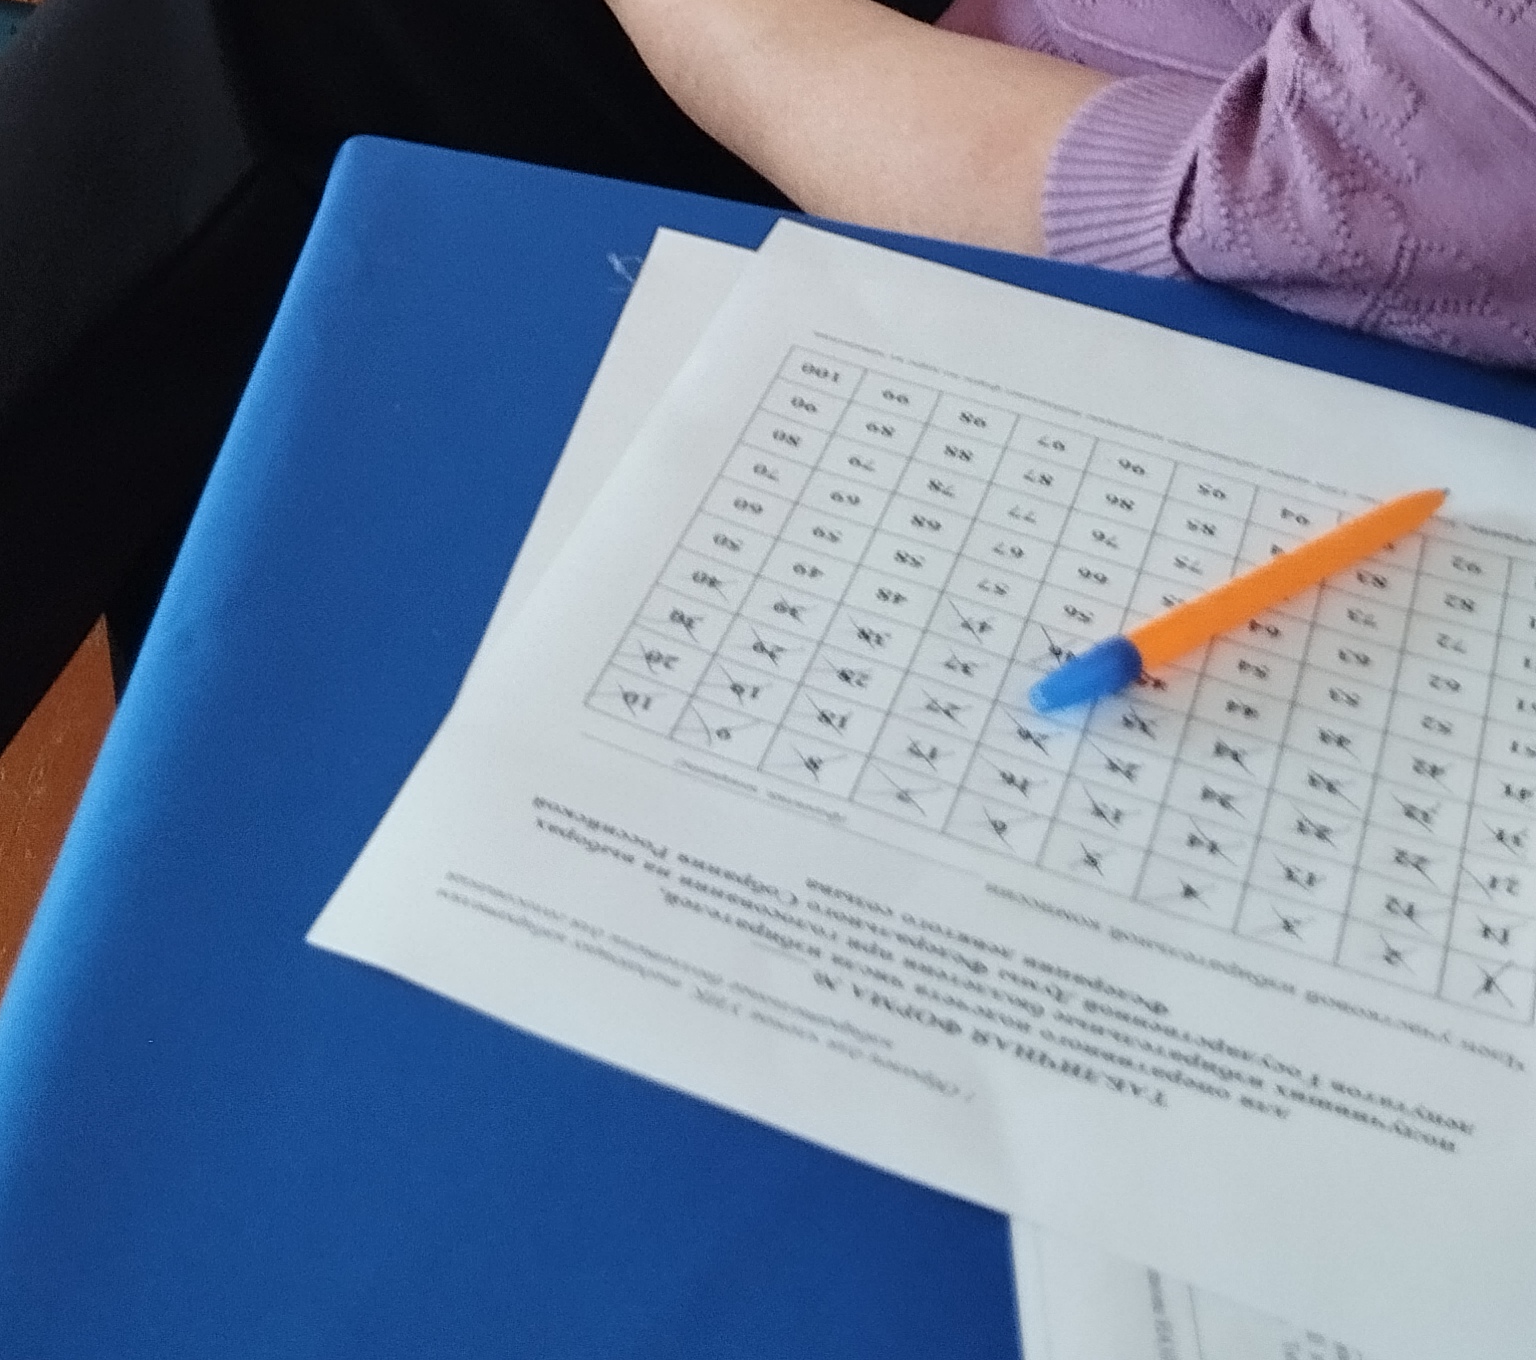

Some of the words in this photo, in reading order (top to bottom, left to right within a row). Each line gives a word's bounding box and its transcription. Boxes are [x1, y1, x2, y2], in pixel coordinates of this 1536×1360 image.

[798, 362, 842, 383] 100
[786, 396, 819, 414] 90
[879, 388, 911, 406] 99
[862, 419, 895, 438] 89
[956, 410, 988, 429] 98
[768, 428, 801, 447] 80
[1035, 434, 1067, 453] 97
[845, 453, 878, 473] 79
[941, 443, 974, 462] 88
[749, 462, 783, 482] 70
[1021, 467, 1054, 487] 87
[1115, 457, 1147, 476] 96
[827, 488, 861, 508] 69
[925, 478, 958, 498] 78
[1195, 482, 1227, 501] 95
[730, 496, 764, 516] 60
[1102, 491, 1135, 511] 86
[908, 513, 942, 533] 68
[1005, 504, 1039, 524] 77
[1278, 506, 1311, 526] 94
[809, 523, 843, 544] 59
[1183, 517, 1216, 537] 85
[710, 532, 745, 553] 50
[1088, 529, 1121, 549] 76
[892, 548, 926, 569] 58
[990, 540, 1024, 561] 67
[790, 560, 825, 582] 49
[1074, 564, 1109, 585] 66
[1171, 554, 1205, 575] 75
[1449, 555, 1482, 576] 92
[975, 576, 1010, 597] 57
[1354, 568, 1387, 589] 83
[874, 587, 909, 608] 48
[1442, 592, 1475, 614] 82
[1060, 603, 1095, 624] 56
[1344, 607, 1378, 628] 73
[1247, 618, 1281, 640] 64
[1434, 632, 1468, 654] 72
[1335, 645, 1370, 668] 63
[1236, 658, 1271, 680] 54
[1427, 672, 1461, 695] 62
[1326, 685, 1361, 708] 53
[1419, 714, 1454, 737] 52
[531, 796, 668, 859] Российской
[536, 817, 635, 864] выборах
[642, 860, 671, 878] на
[676, 853, 799, 906] Собрания
[805, 877, 893, 916] созыва
[984, 882, 1101, 931] комиссии
[678, 875, 837, 941] голосовании
[659, 887, 821, 958] избирателей,
[806, 901, 988, 975] Федерального
[900, 914, 1013, 959] девятого
[845, 936, 893, 961] при
[1107, 925, 1296, 995] избирательной
[813, 971, 835, 990] №
[830, 953, 904, 989] числа
[902, 957, 1045, 1018] бюллетени
[997, 969, 1072, 1004] Думы
[1022, 956, 1169, 1015] Федерации
[852, 983, 962, 1035] ФОРМА
[1303, 990, 1451, 1044] участковой
[1052, 1010, 1264, 1089] избирательные
[1082, 998, 1320, 1088] Государственной
[970, 1028, 1164, 1106] ТАБЛИЧНАЯ
[1039, 1029, 1230, 1099] оперативного
[1238, 1094, 1288, 1118] для
[1330, 1080, 1473, 1135] депутатов
[1275, 1084, 1455, 1152] получивших
